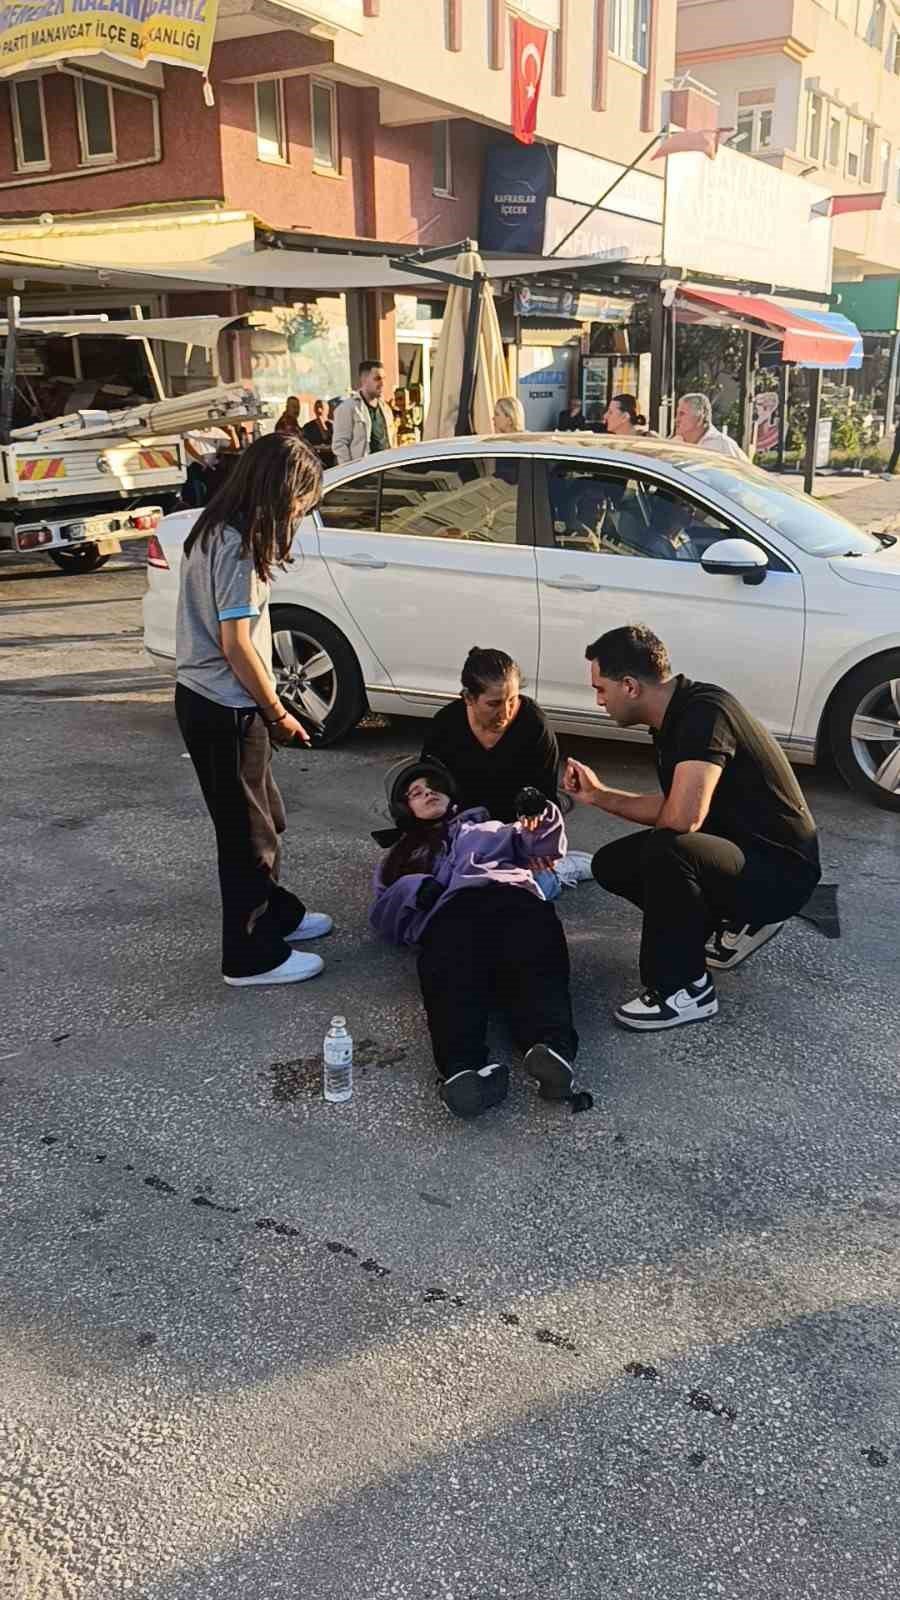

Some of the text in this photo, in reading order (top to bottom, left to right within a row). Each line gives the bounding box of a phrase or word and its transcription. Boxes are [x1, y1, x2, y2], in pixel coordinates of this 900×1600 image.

[31, 22, 92, 44] MANAVGAT
[95, 19, 126, 43] İLÇE
[130, 26, 201, 51] BAKANLIĞI
